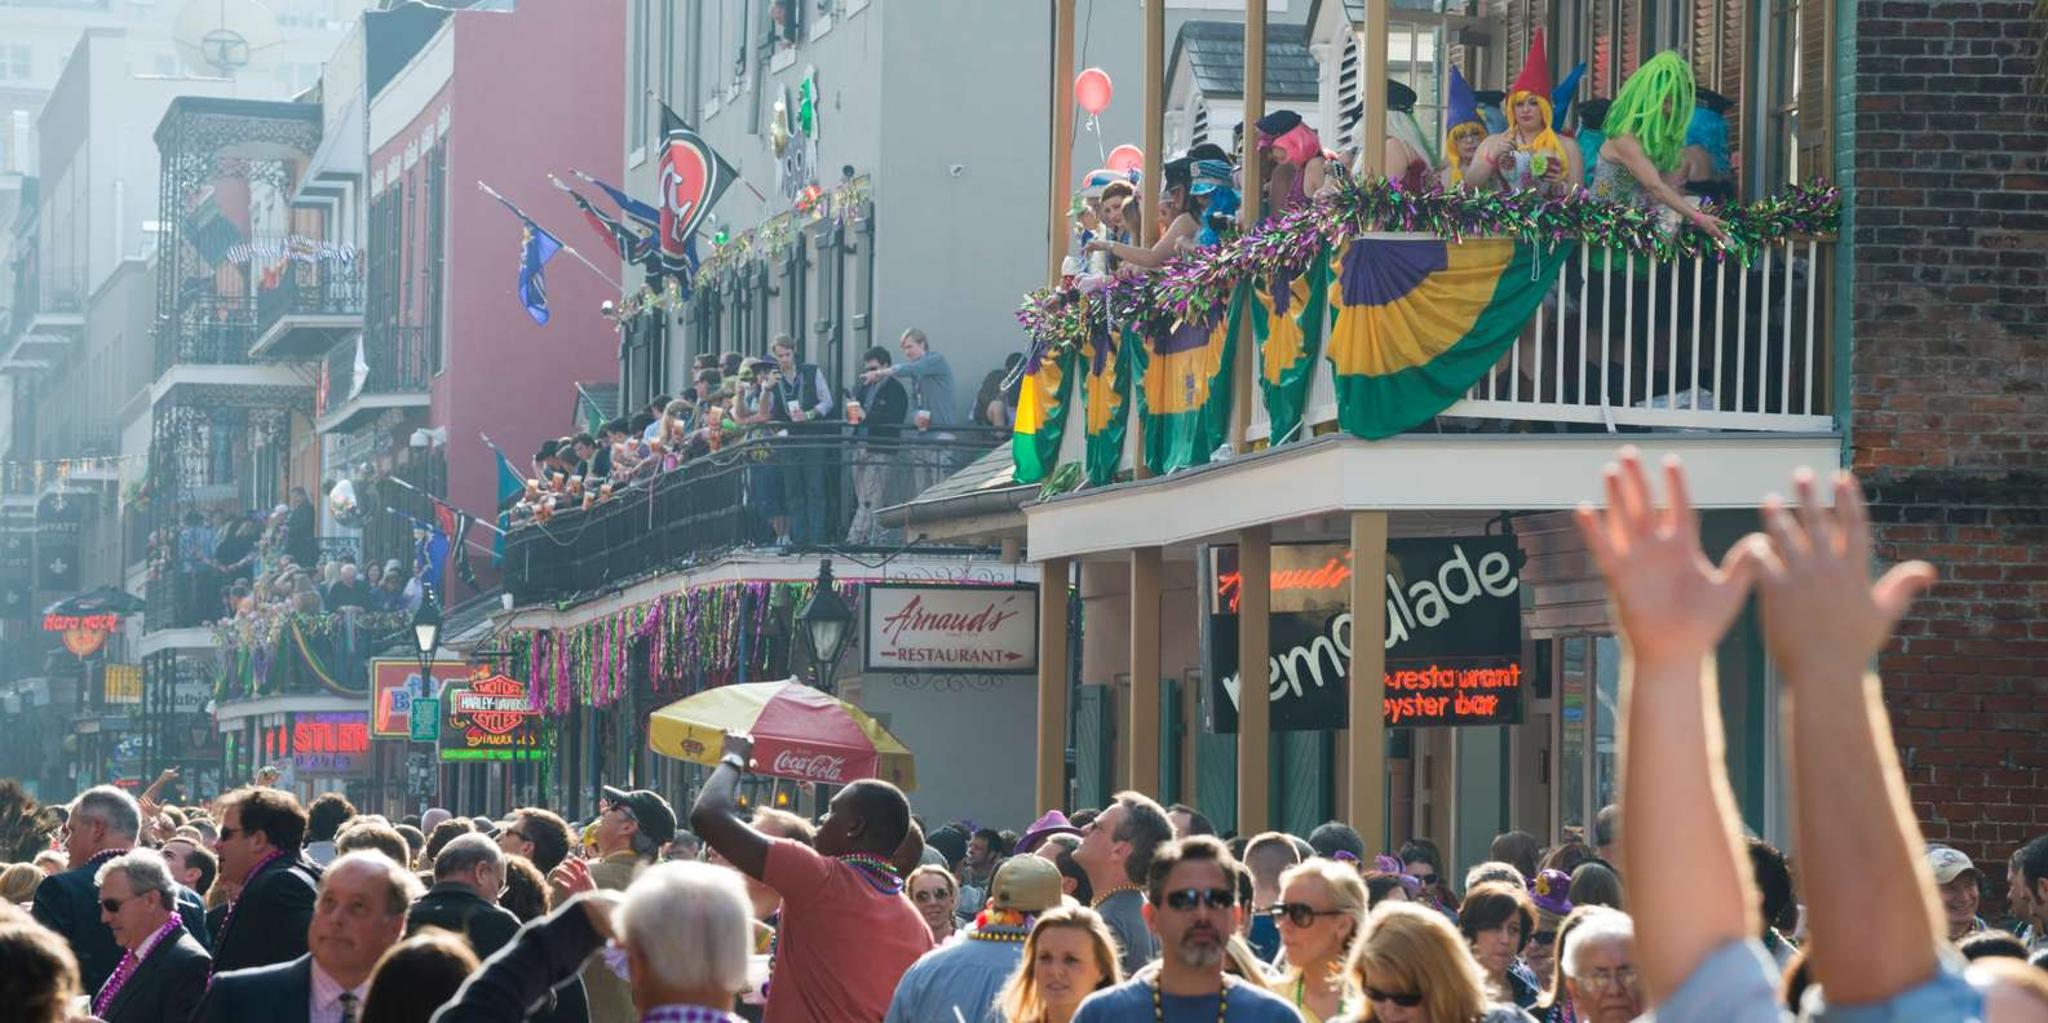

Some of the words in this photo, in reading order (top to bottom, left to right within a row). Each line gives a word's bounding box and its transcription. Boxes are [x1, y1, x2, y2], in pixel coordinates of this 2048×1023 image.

[897, 648, 1004, 663] RESTAURANT
[1393, 663, 1521, 690] restaurant
[1455, 689, 1499, 716] bar
[477, 712, 518, 730] CYCLES
[774, 749, 848, 780] Coca-Cola
